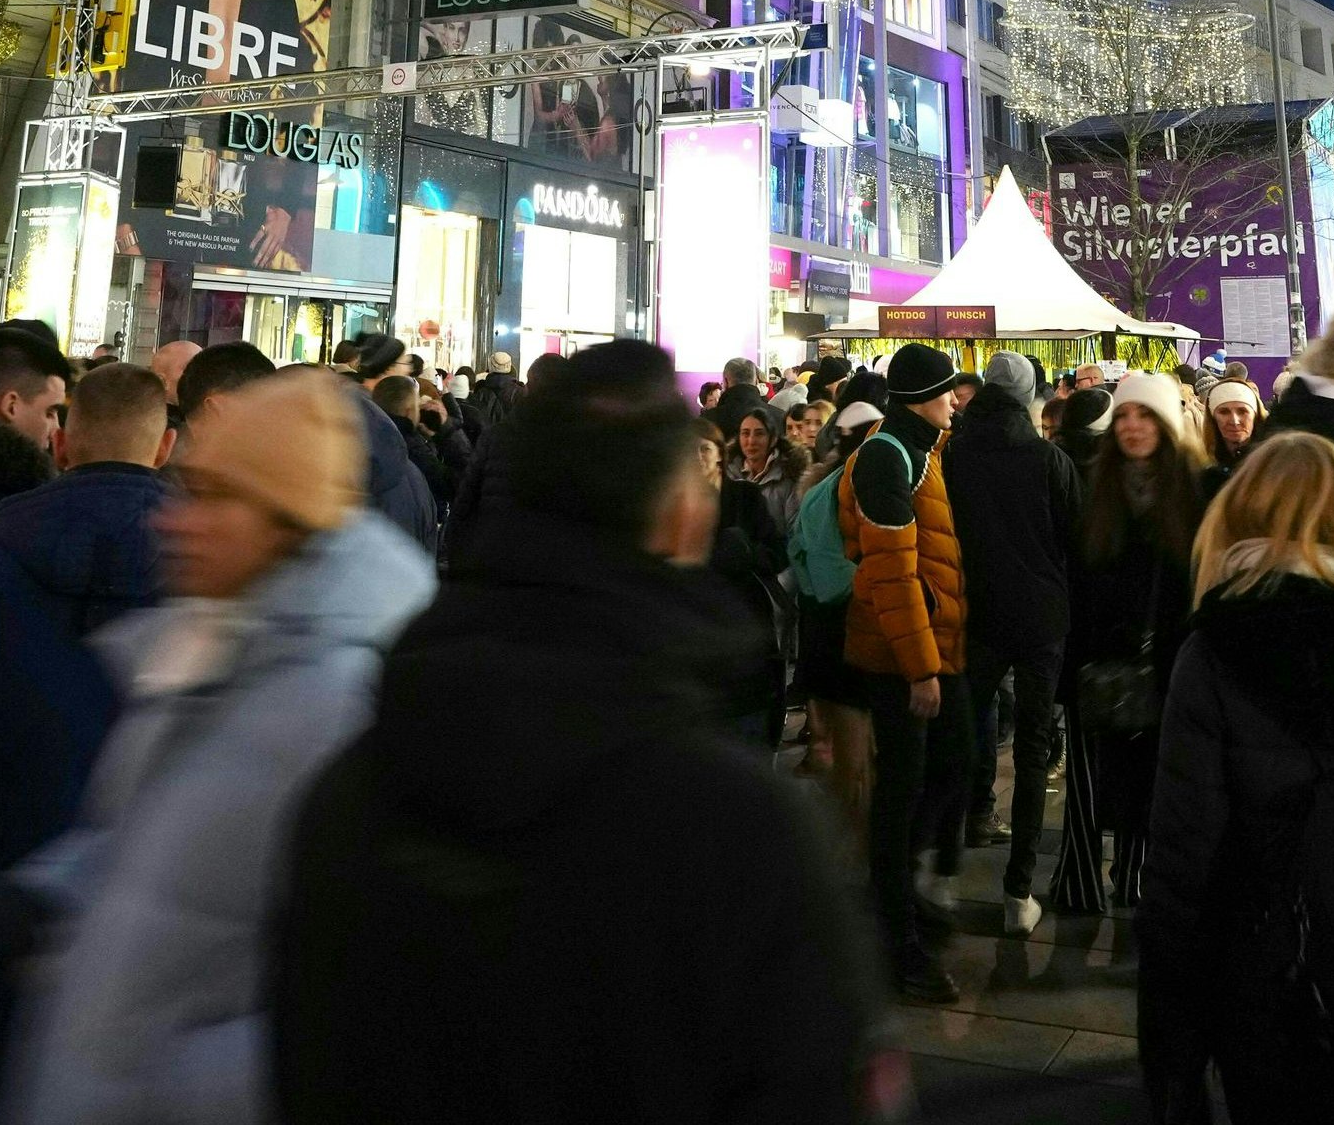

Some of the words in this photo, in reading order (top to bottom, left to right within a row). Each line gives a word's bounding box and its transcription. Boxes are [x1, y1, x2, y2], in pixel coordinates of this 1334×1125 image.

[228, 111, 363, 169] DOUGLAS
[1060, 196, 1193, 226] Wiener
[177, 231, 202, 240] ORIGINAL
[221, 236, 240, 244] PARFUM
[198, 242, 216, 250] ABSOLU
[218, 243, 237, 252] PLATINE
[1062, 222, 1305, 267] Silvesterpfad
[886, 311, 926, 320] HOTDOG
[946, 311, 986, 320] PUNSCH
